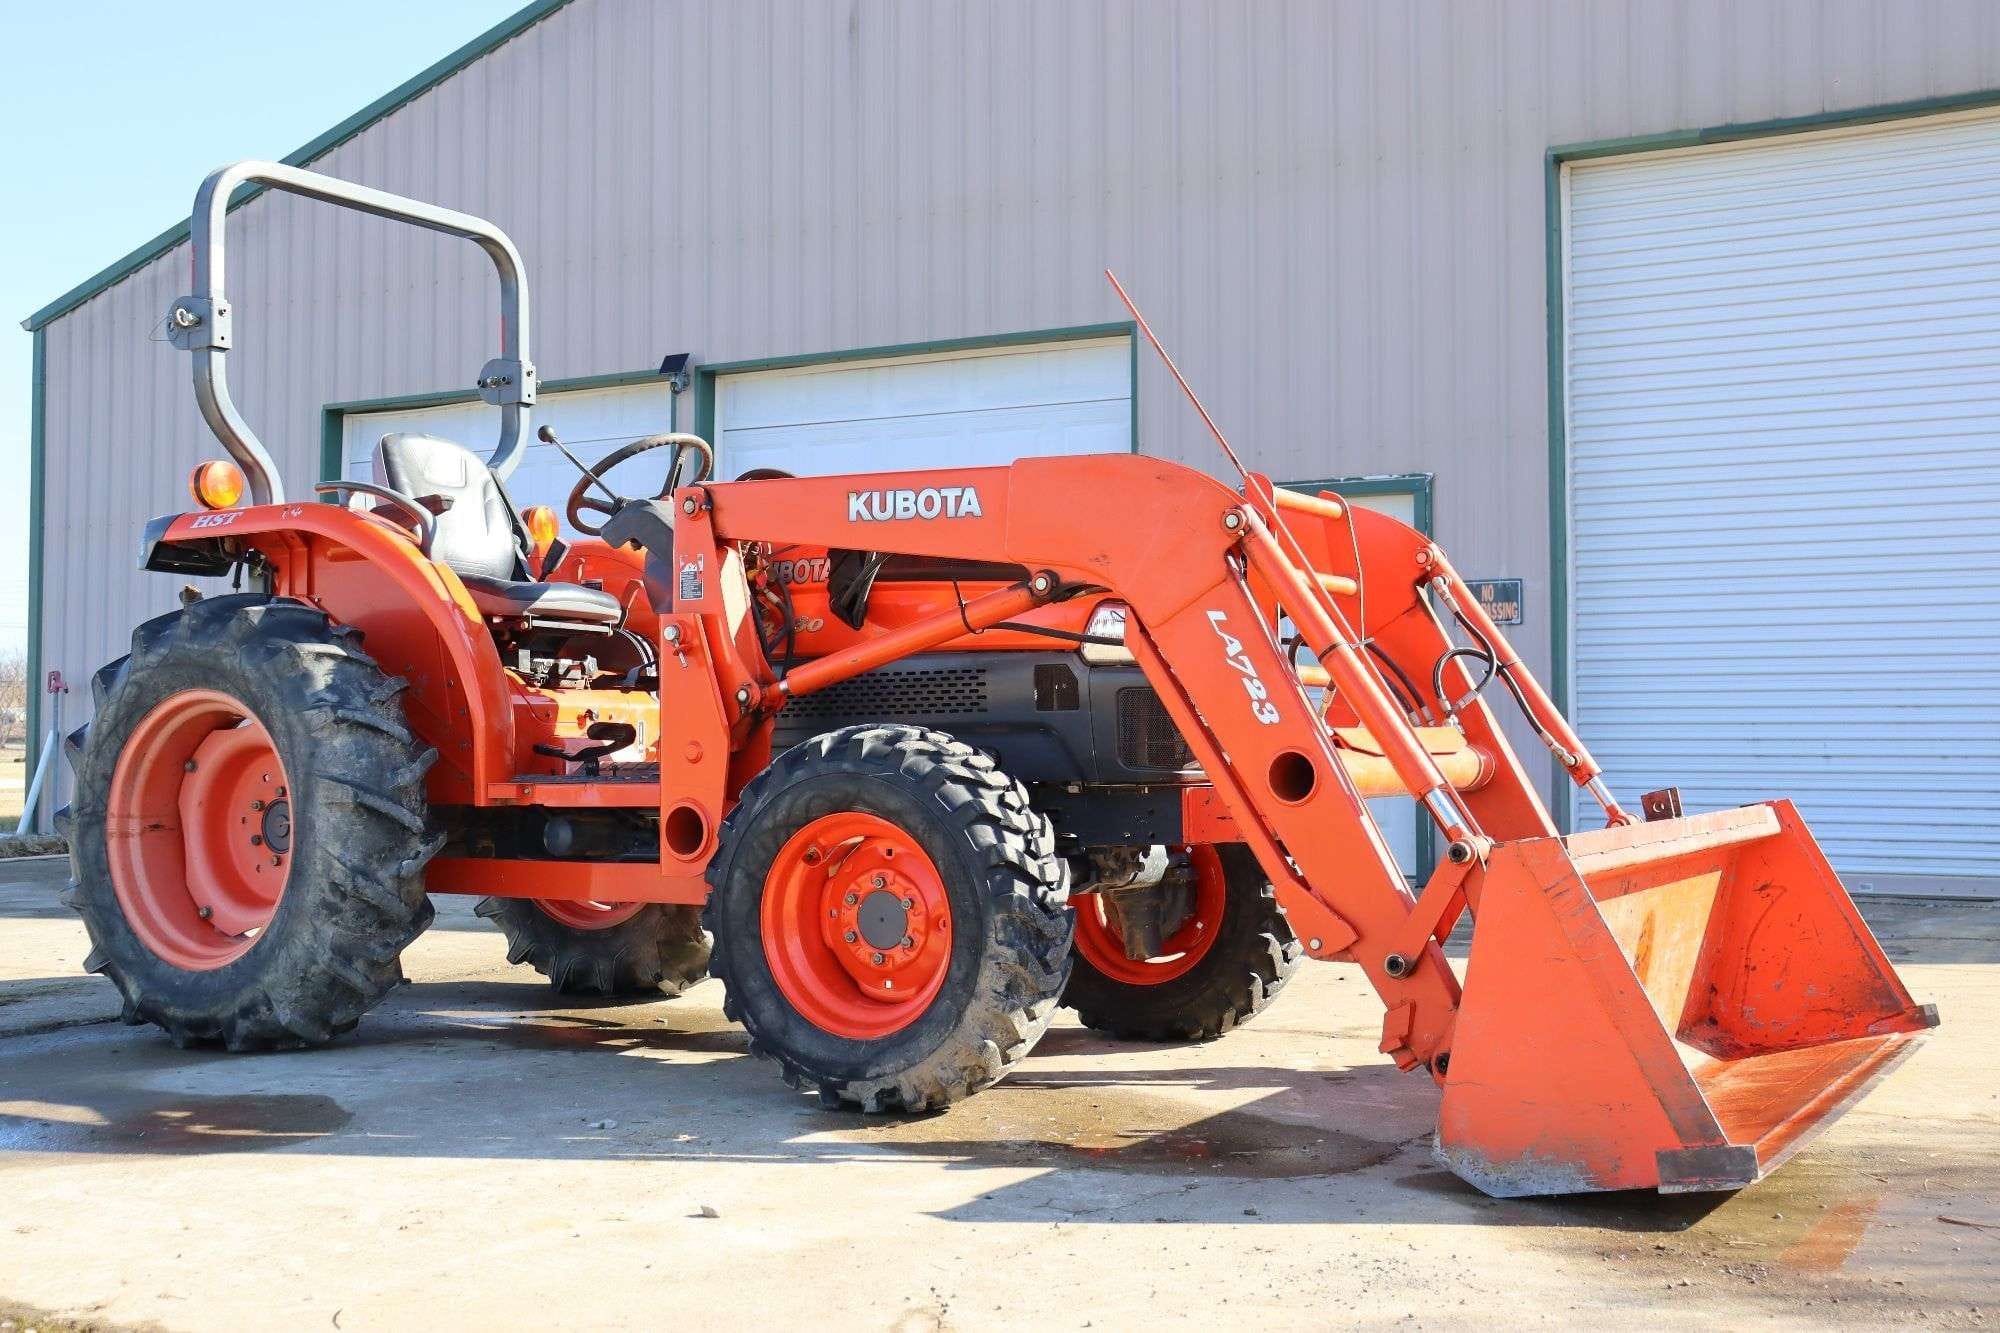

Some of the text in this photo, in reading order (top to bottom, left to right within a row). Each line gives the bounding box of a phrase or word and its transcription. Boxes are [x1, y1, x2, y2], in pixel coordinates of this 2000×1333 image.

[848, 486, 982, 521] KUBOTA
[190, 511, 244, 529] HST
[1481, 584, 1494, 602] NO
[1206, 610, 1280, 724] LA723
